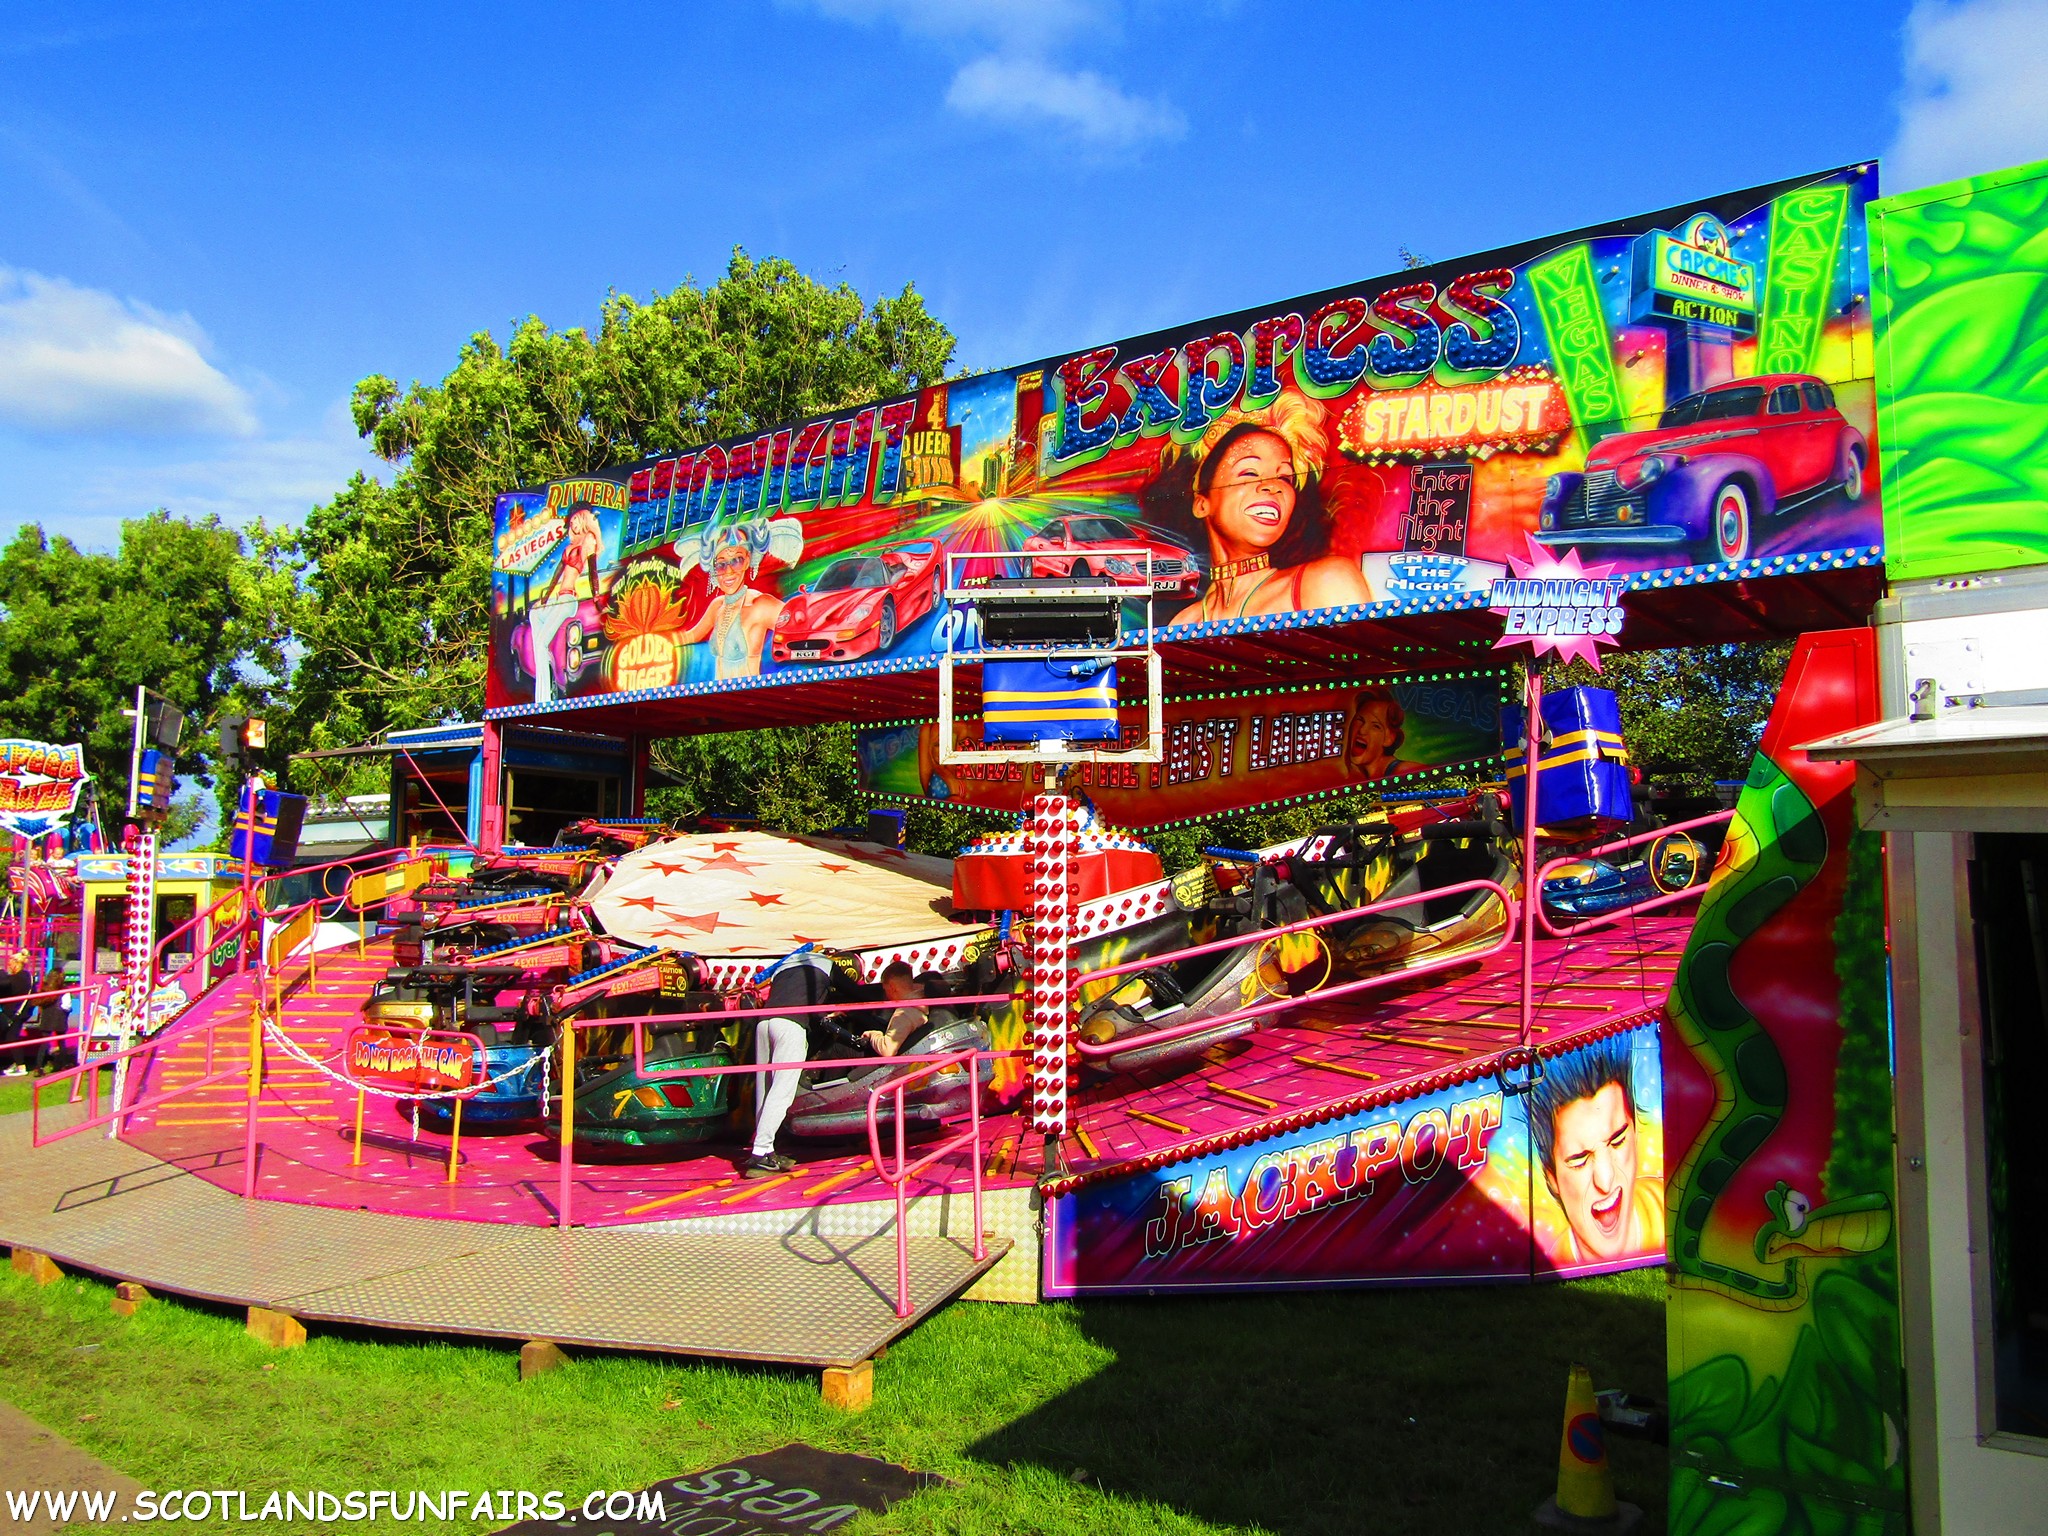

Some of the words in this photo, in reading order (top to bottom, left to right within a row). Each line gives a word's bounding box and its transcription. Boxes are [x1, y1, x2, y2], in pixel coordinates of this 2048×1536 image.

[1670, 273, 1709, 292] DINNER
[1710, 283, 1719, 295] &
[1721, 287, 1745, 302] SHOW
[1766, 190, 1835, 374] CASINO
[1672, 298, 1739, 328] ACTION
[1535, 259, 1613, 420] VEGAS
[1054, 267, 1521, 464] Express
[1363, 385, 1550, 444] STARDUST
[622, 398, 918, 550] MIDNIGHT
[1410, 465, 1469, 492] Enter
[545, 481, 627, 519] RIVIERA
[1416, 487, 1456, 516] the
[501, 547, 522, 569] LAS
[523, 525, 564, 558] VEGAS
[1397, 510, 1463, 553] Night
[1389, 554, 1469, 567] ENTER
[1402, 565, 1452, 577] THE
[1385, 578, 1466, 591] NIGHT
[1489, 579, 1625, 607] MIDNIGHT
[1504, 606, 1625, 636] EXPRESS
[618, 633, 673, 667] GOLDEN
[1391, 684, 1499, 732] VEGAS
[1151, 717, 1238, 788] FAST
[1249, 711, 1345, 771] LANE
[521, 957, 539, 968] EXIT
[659, 967, 683, 975] CAUTION
[355, 1041, 371, 1068] DO
[370, 1045, 391, 1072] NOT
[390, 1045, 418, 1073] ROCK
[438, 1048, 463, 1081] CAR
[1145, 1090, 1504, 1259] JACKPOT
